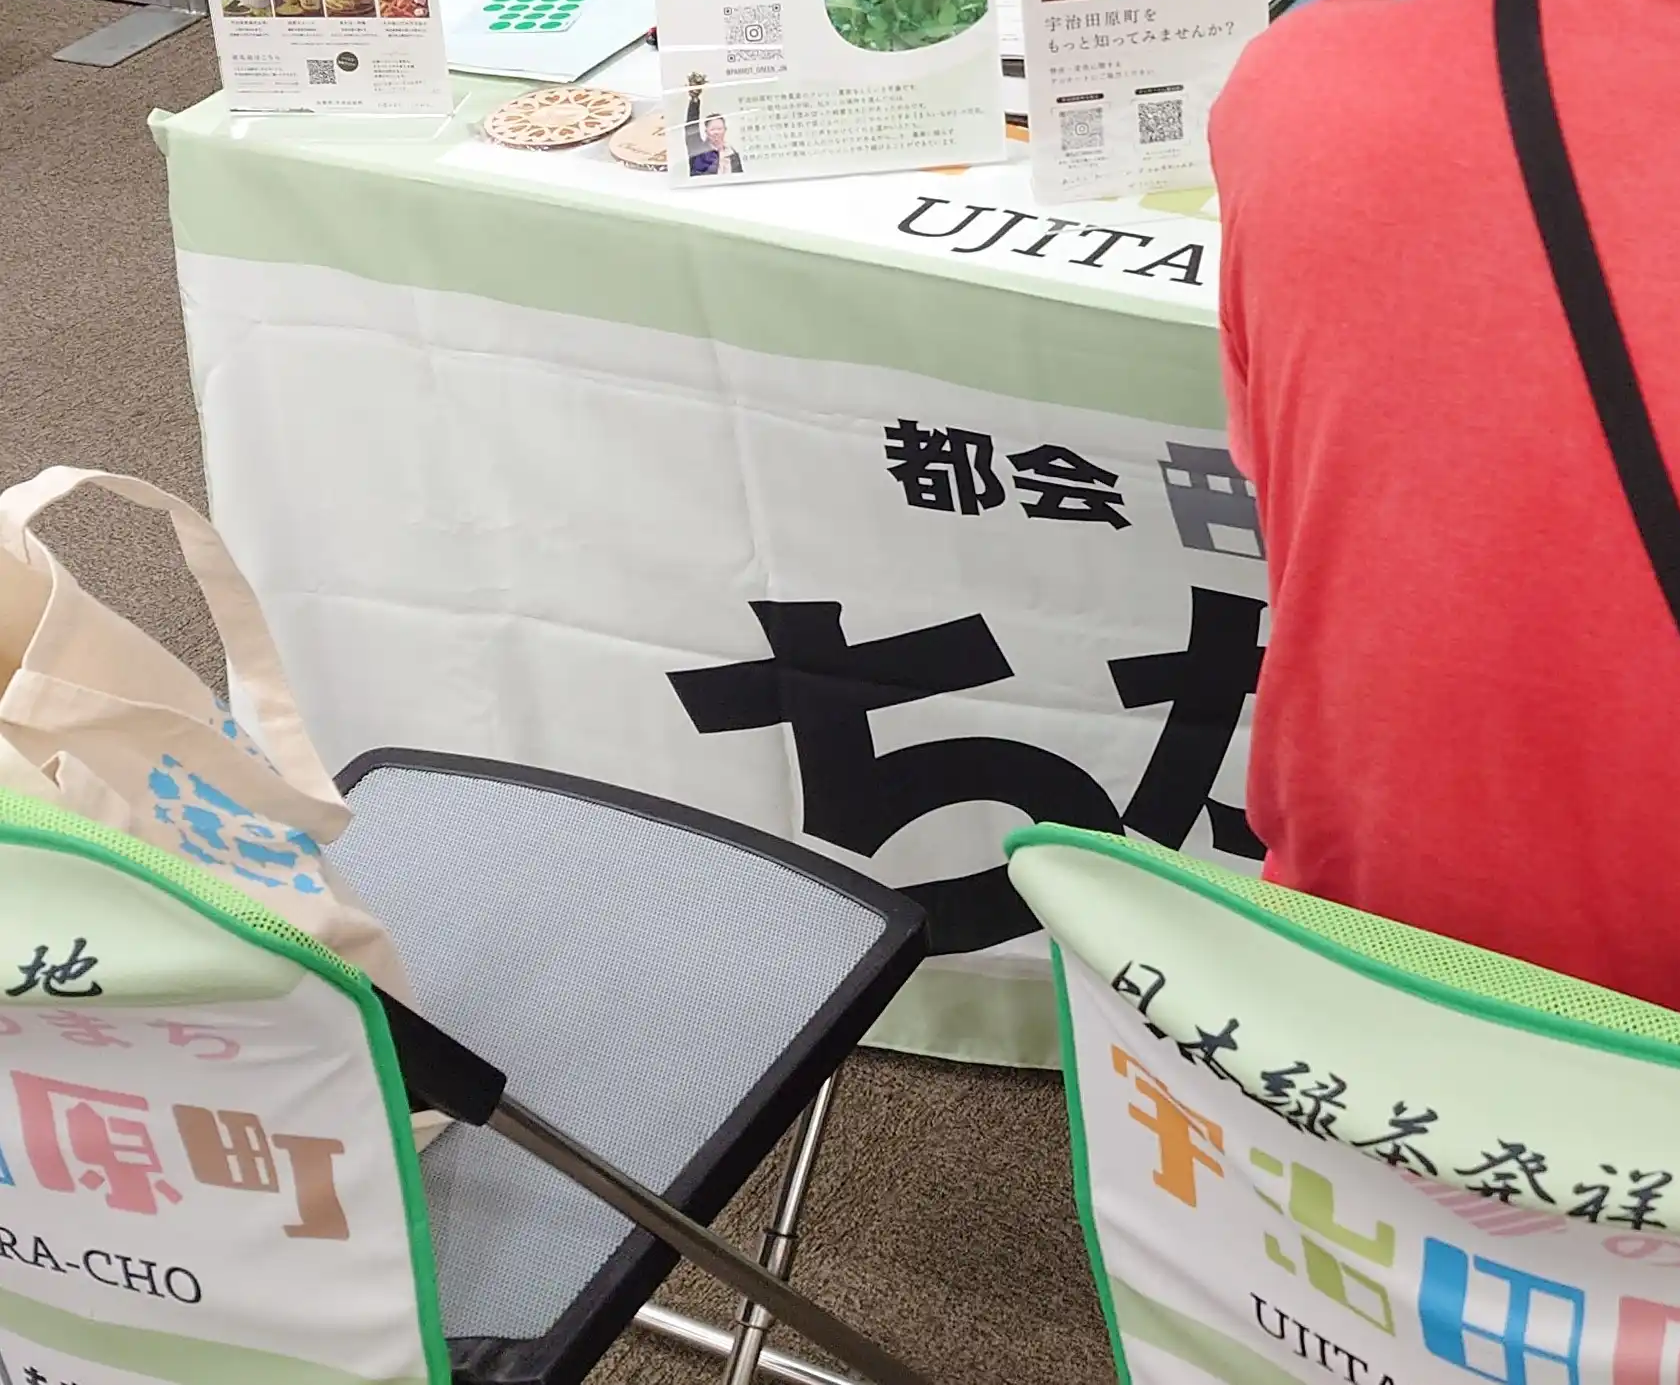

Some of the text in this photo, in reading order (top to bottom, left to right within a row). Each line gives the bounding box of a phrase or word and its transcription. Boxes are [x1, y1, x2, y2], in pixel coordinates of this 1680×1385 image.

[1044, 9, 1158, 33] 宇治田原町を
[1048, 21, 1235, 53] もっと知ってみませんか?
[896, 196, 1204, 286] UJITA
[883, 419, 1132, 531] 都会
[0, 1011, 241, 1061] まち
[0, 1070, 350, 1241] 原町
